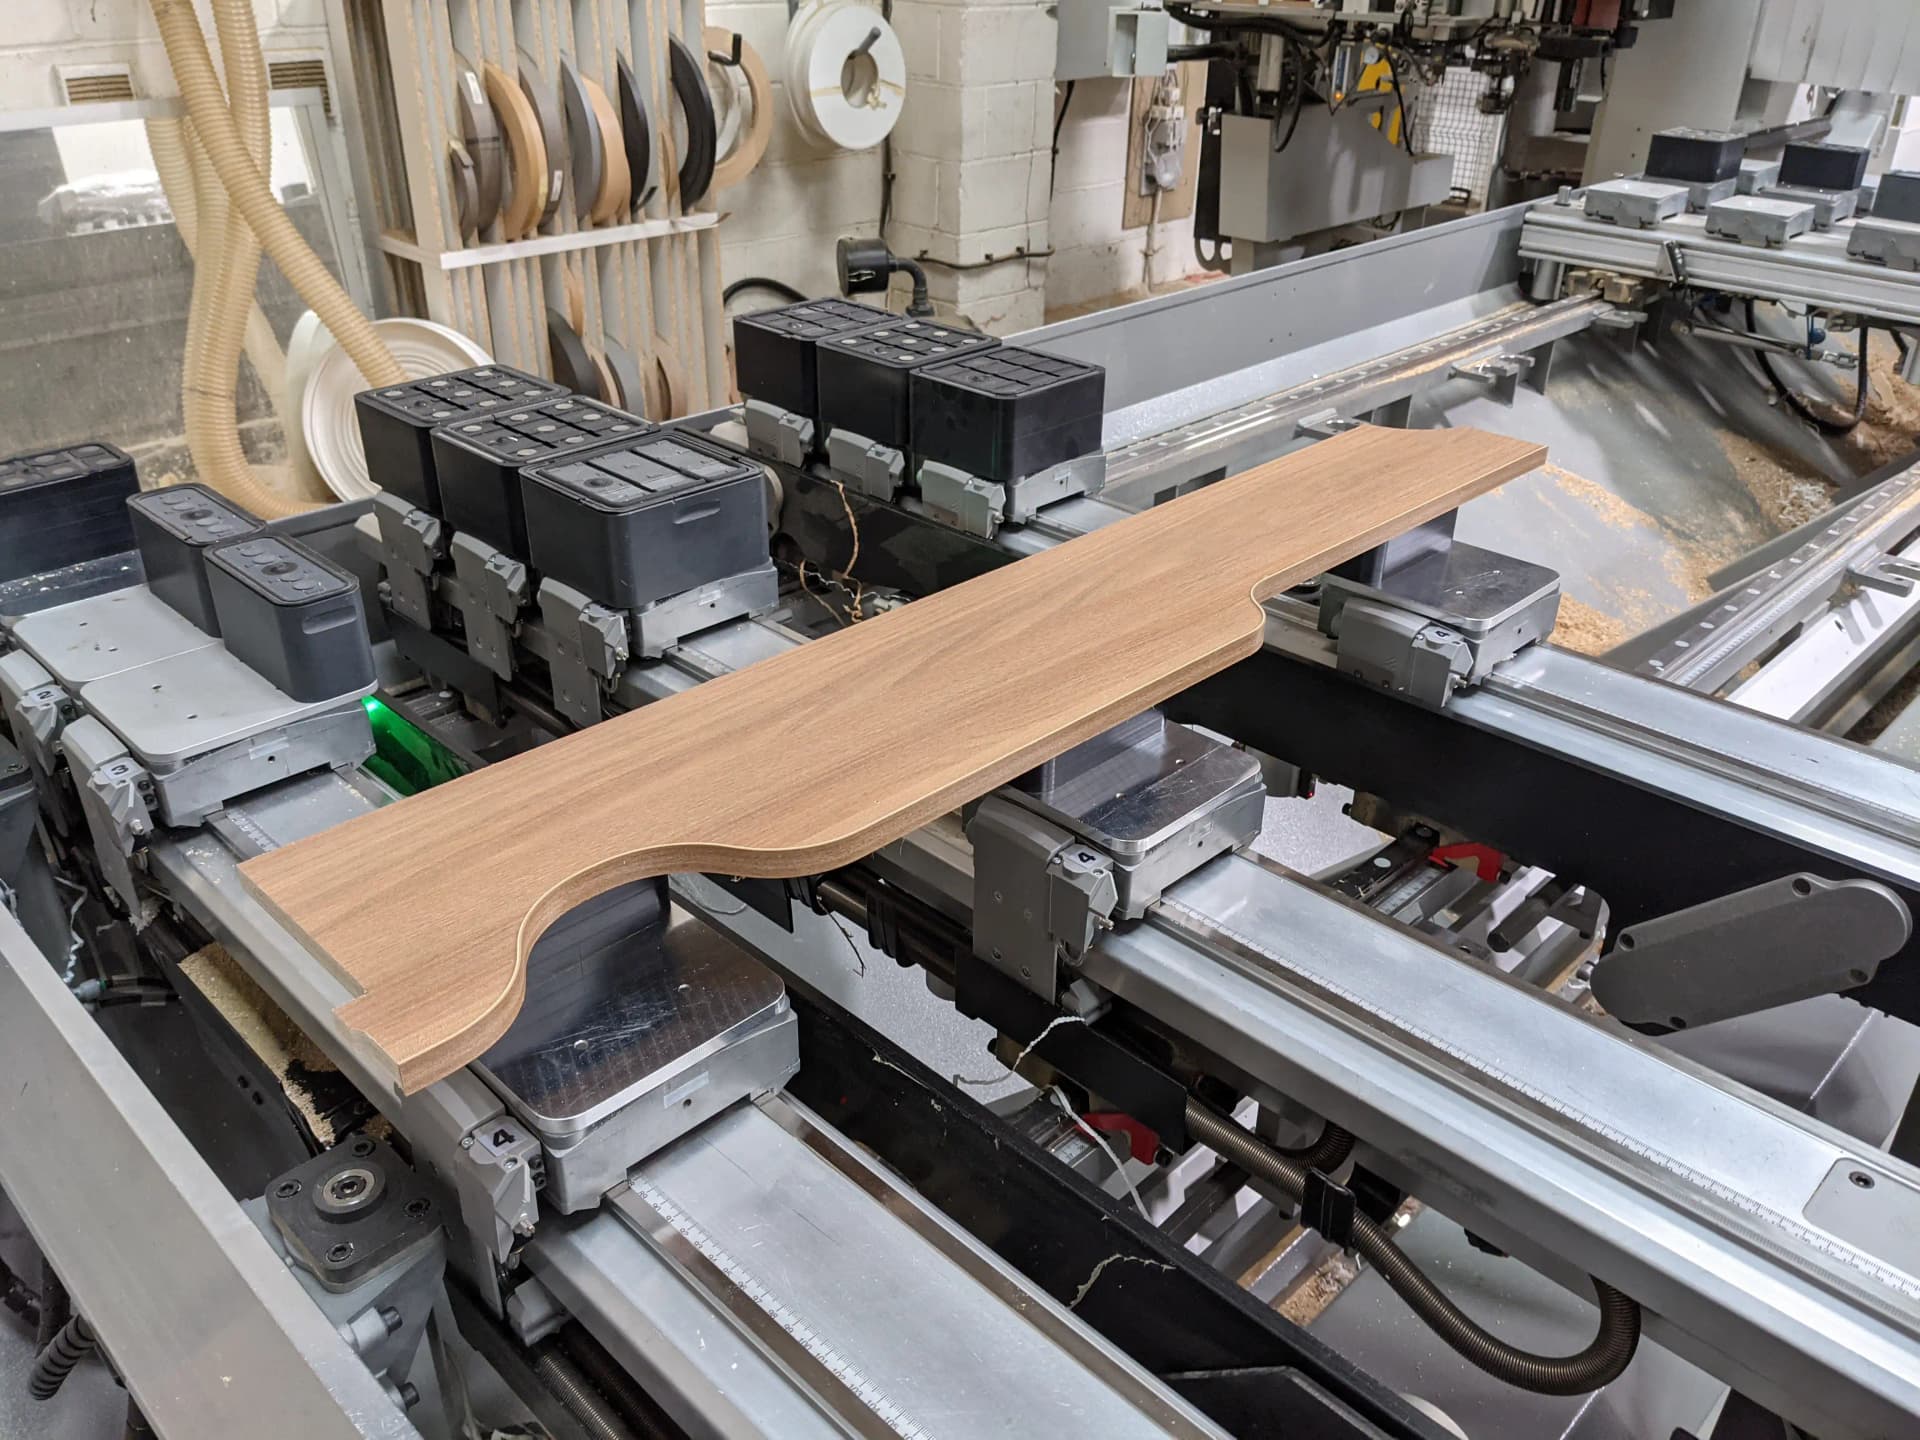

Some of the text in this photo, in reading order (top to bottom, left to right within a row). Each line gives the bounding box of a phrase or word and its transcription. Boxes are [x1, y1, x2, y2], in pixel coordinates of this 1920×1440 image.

[37, 691, 54, 699] 2
[111, 765, 129, 775] 3
[1078, 852, 1096, 862] 4
[493, 1129, 515, 1147] 4
[784, 1323, 794, 1333] 99
[800, 1338, 812, 1350] 100
[816, 1353, 828, 1364] 101
[833, 1368, 846, 1380] 102
[849, 1384, 863, 1397] 103
[886, 1416, 899, 1430] 105
